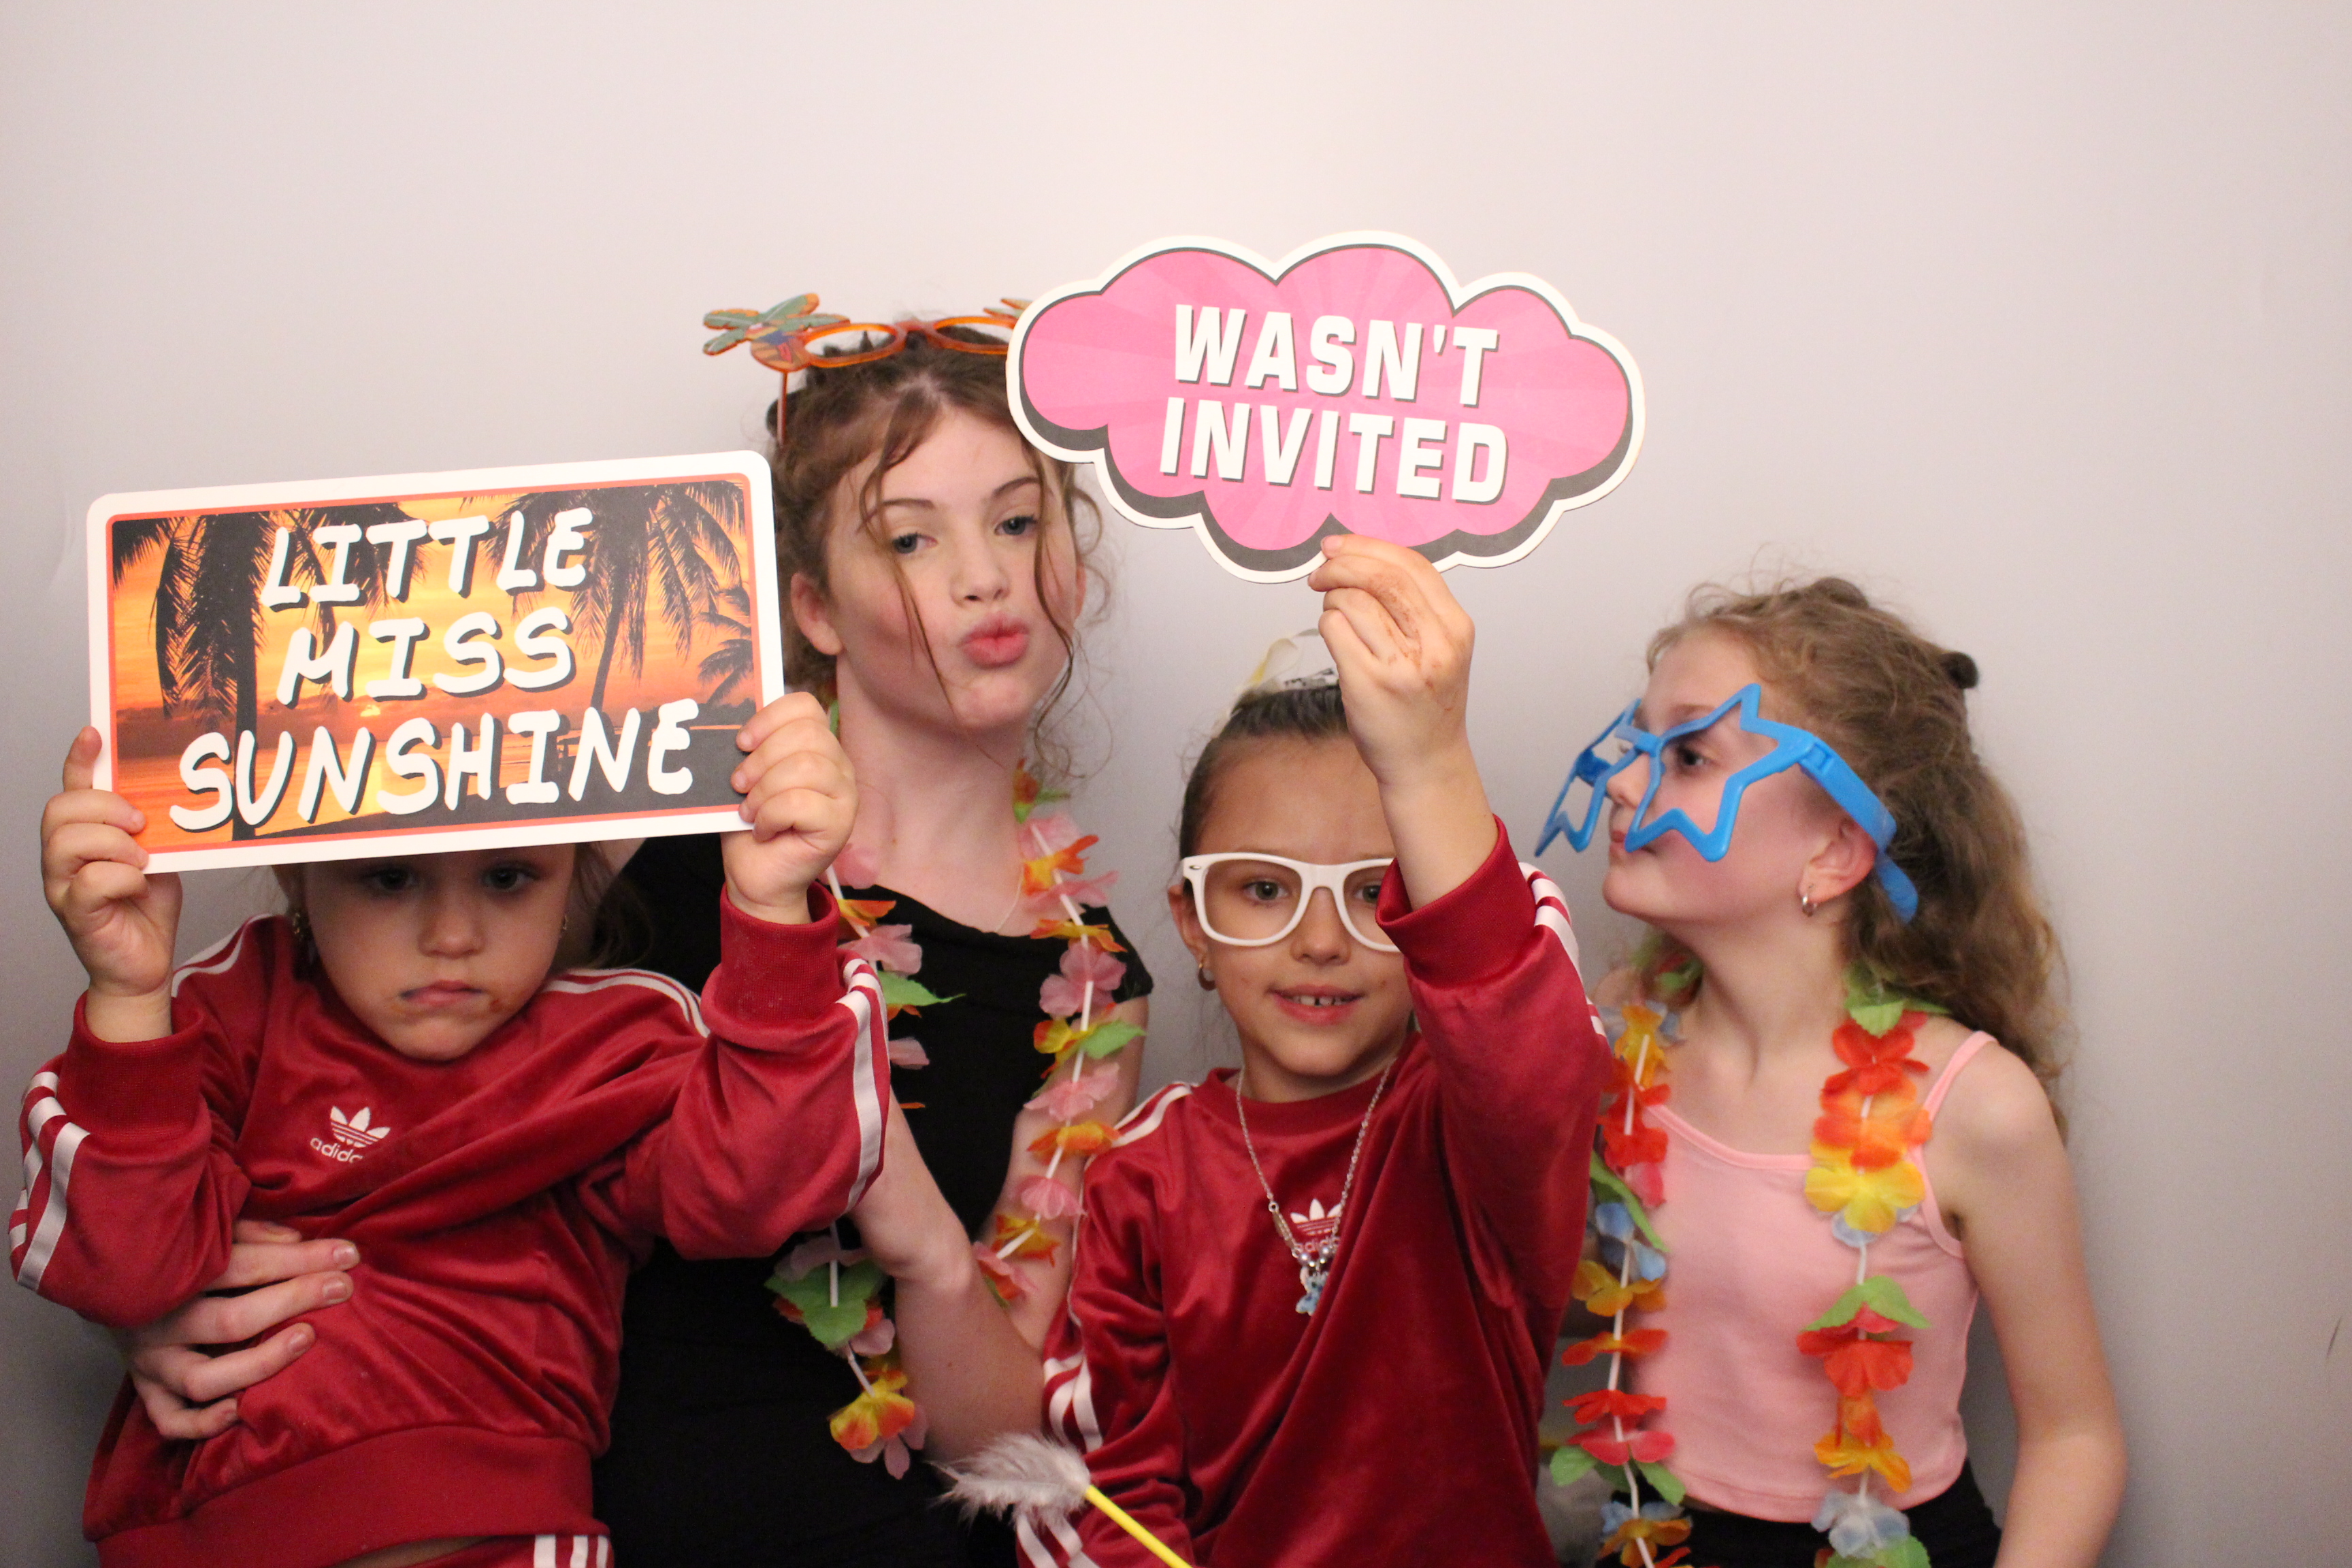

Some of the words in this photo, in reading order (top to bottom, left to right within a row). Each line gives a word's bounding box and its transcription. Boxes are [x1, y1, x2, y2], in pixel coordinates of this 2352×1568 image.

[1175, 304, 1499, 407] WASN'T
[1160, 397, 1508, 504] INVITED
[261, 508, 593, 610] LITTLE
[277, 606, 573, 707] MISS
[169, 698, 702, 832] SUNSHINE
